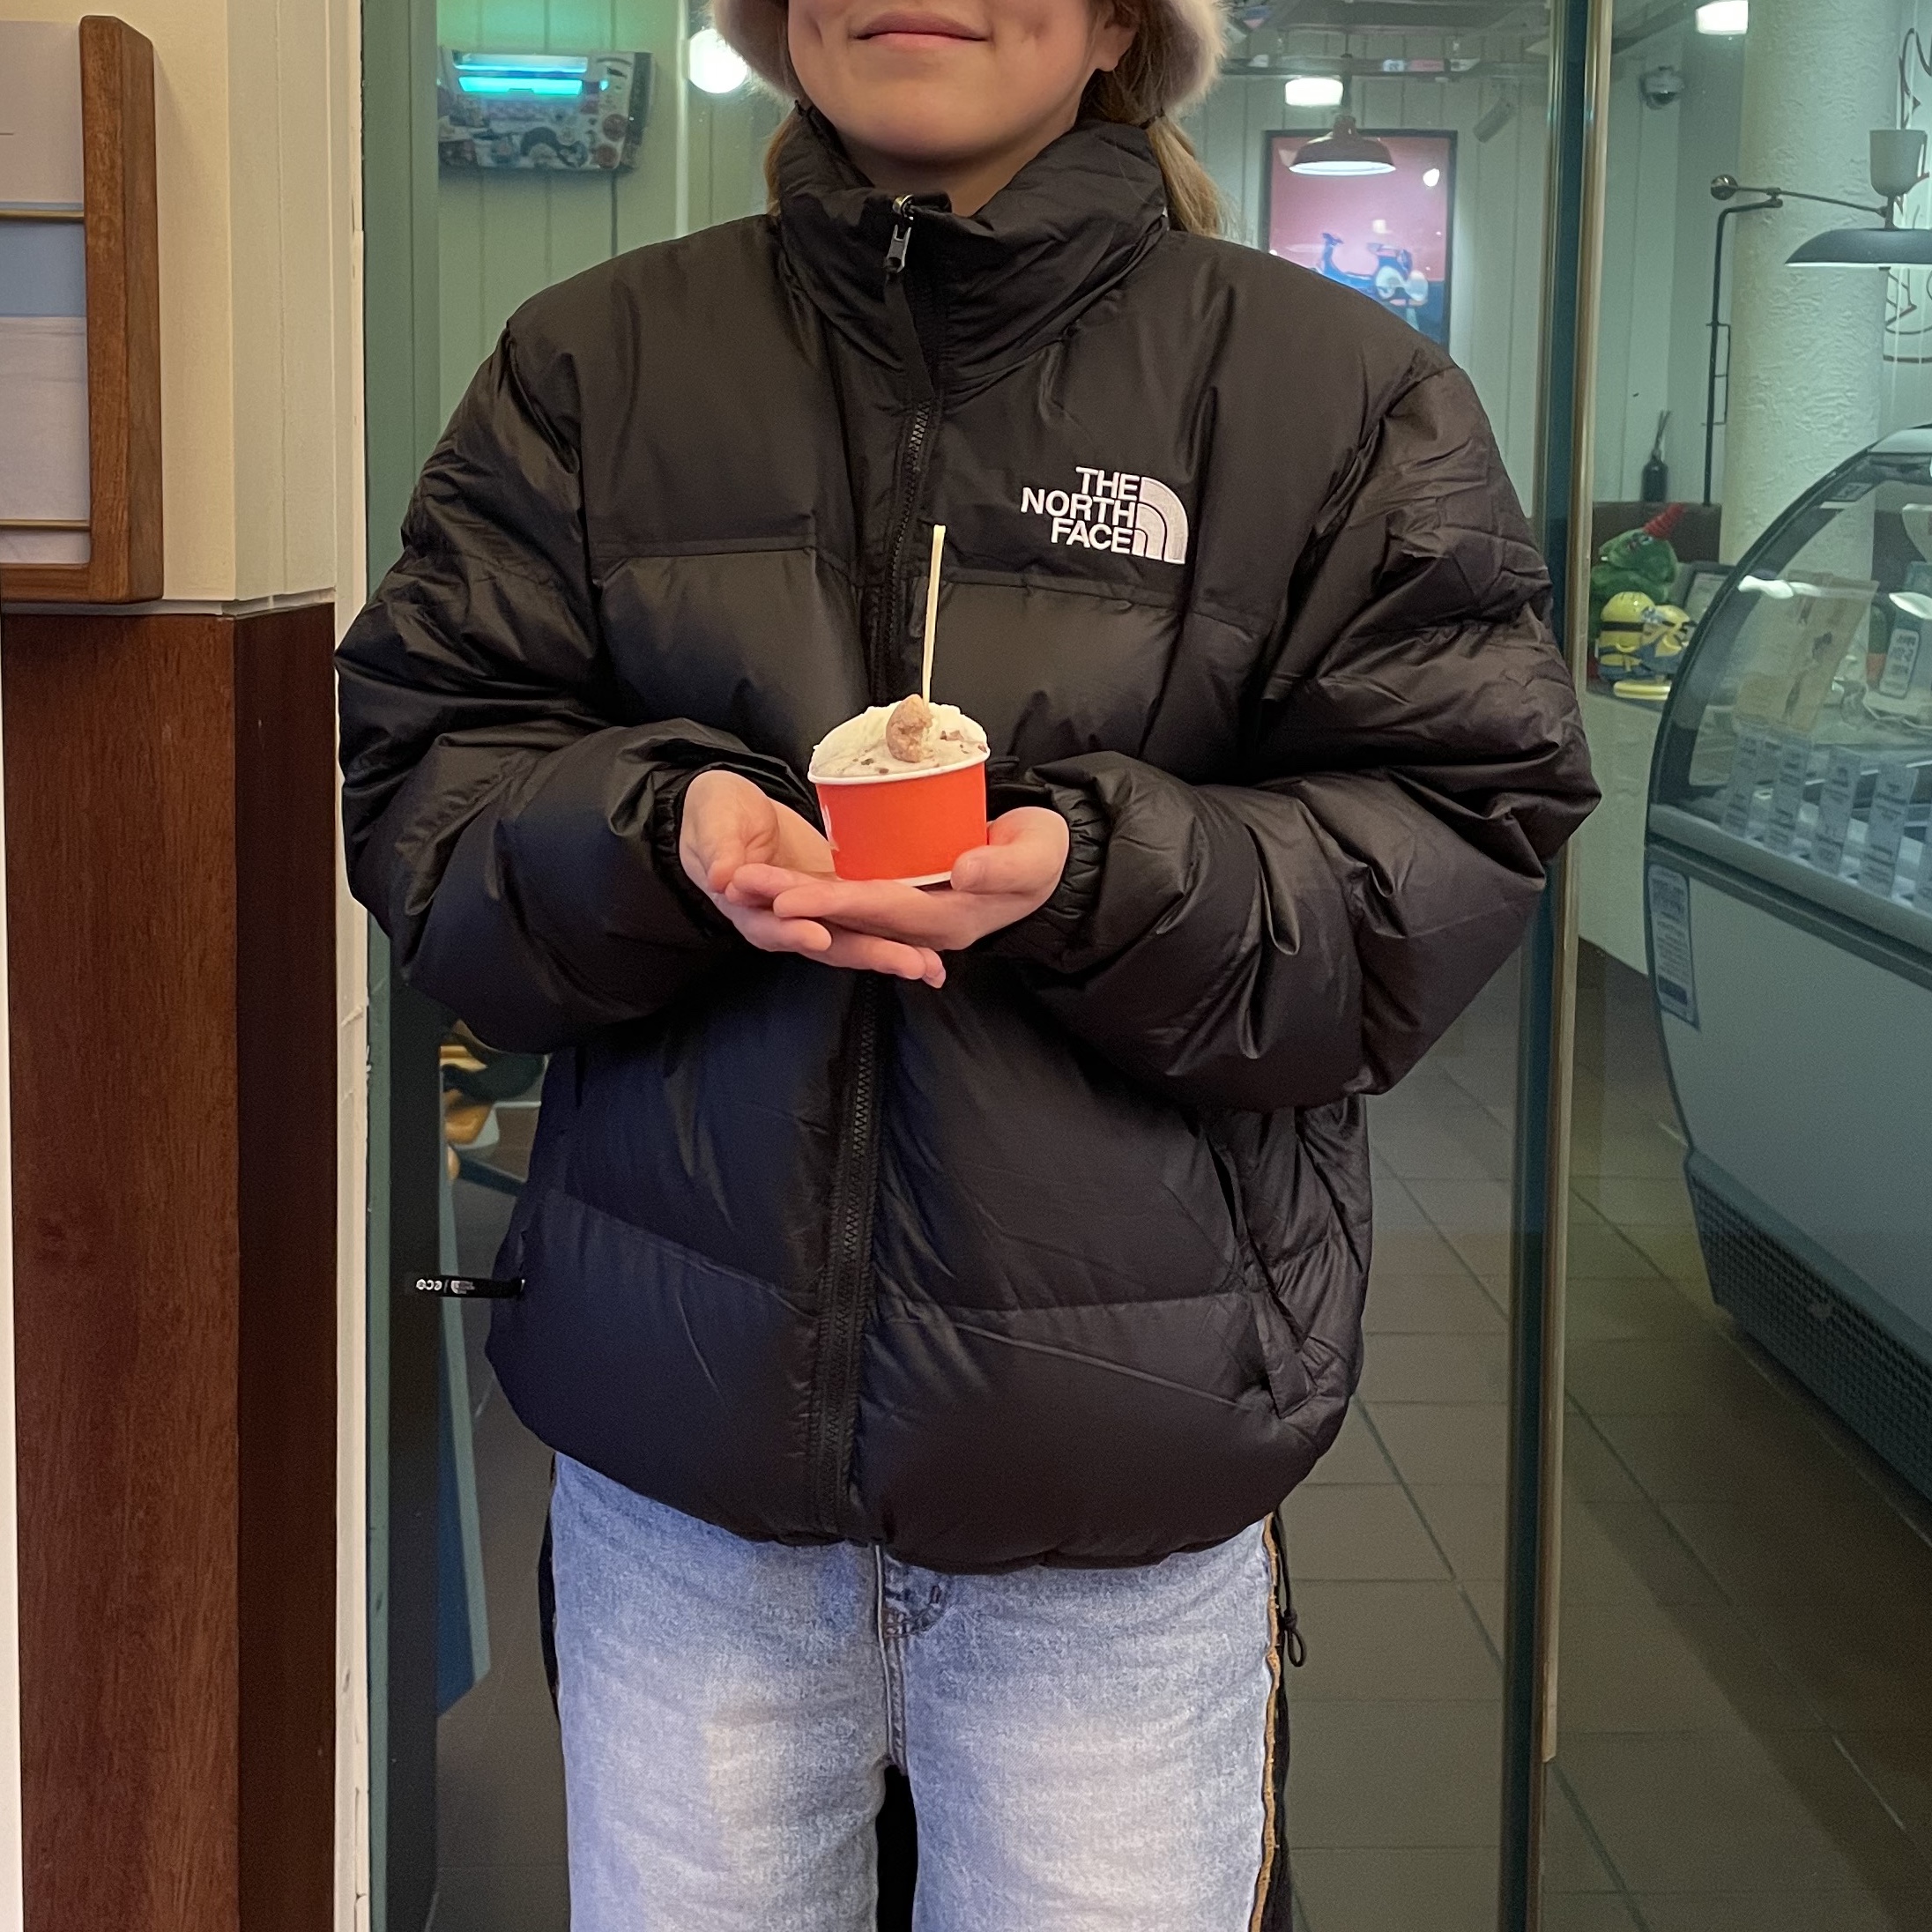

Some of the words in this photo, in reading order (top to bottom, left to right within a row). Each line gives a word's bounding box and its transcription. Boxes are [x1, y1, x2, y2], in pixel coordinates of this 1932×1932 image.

[1075, 466, 1140, 501] THE
[1021, 487, 1135, 528] NORTH
[1051, 517, 1132, 554] FACE
